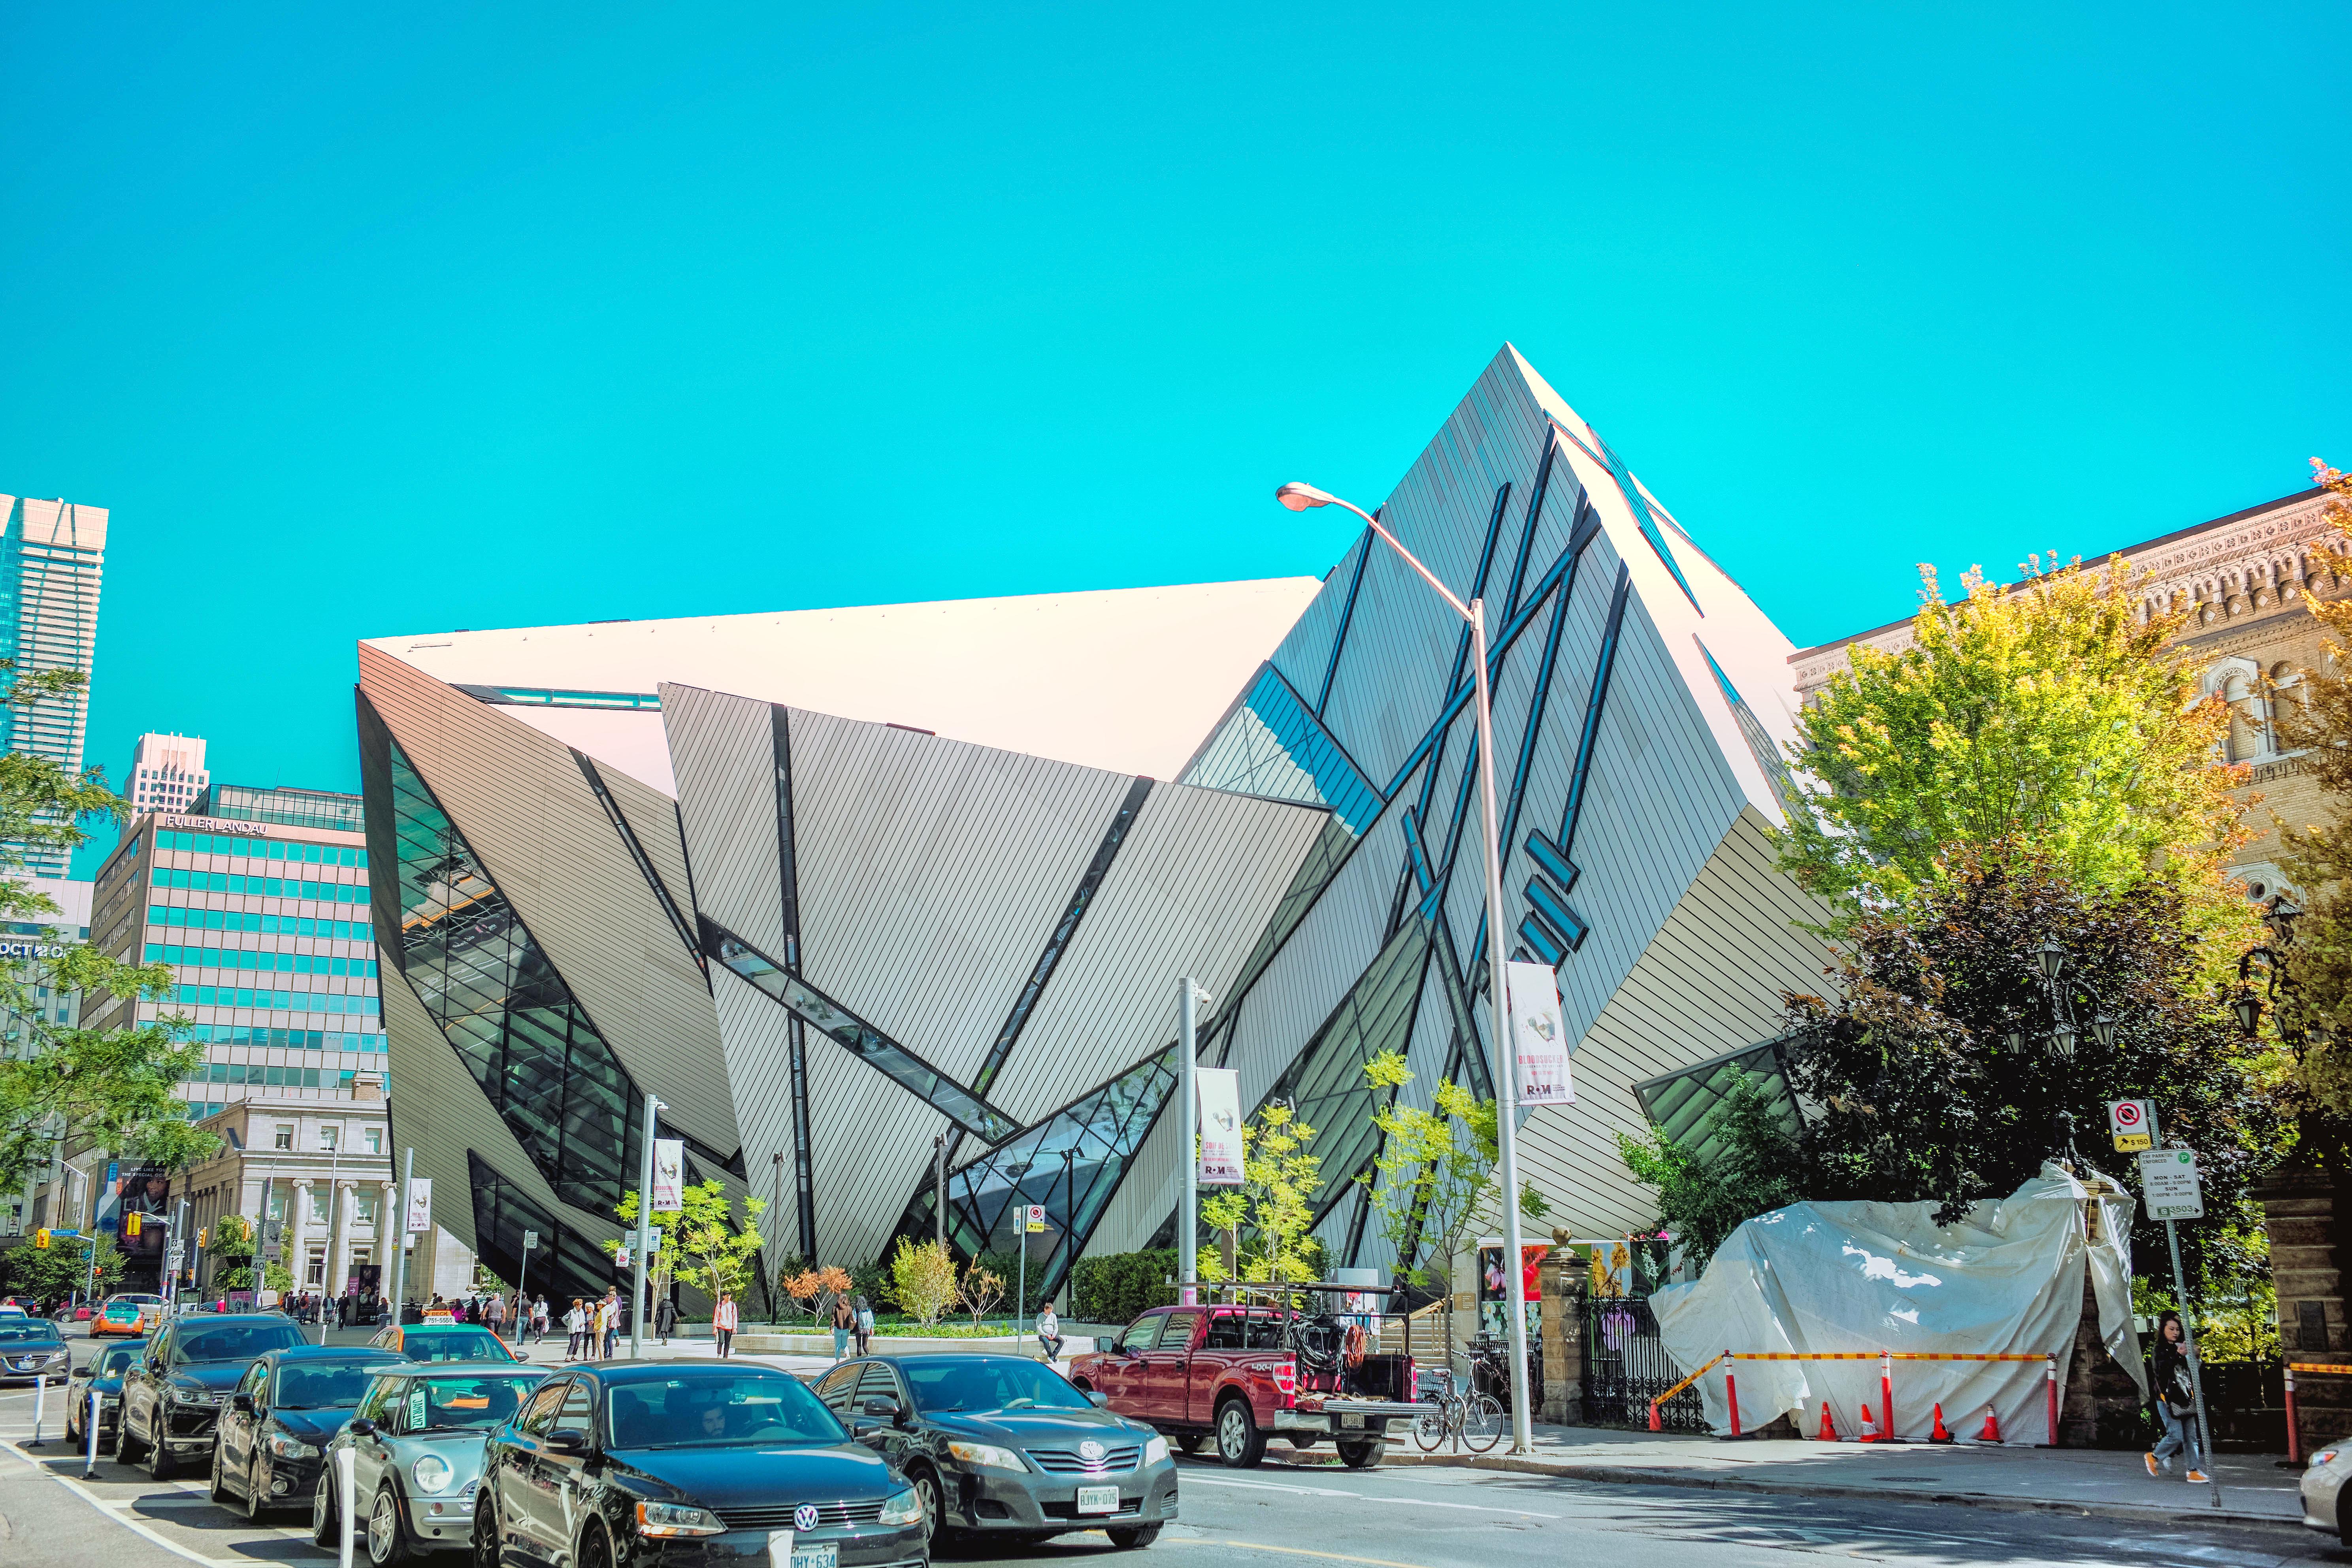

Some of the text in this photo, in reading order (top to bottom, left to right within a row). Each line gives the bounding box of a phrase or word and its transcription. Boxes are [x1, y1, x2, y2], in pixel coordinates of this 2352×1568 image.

[167, 815, 268, 834] FULLER LANDAU
[1519, 1055, 1568, 1064] BLOODSUCKER
[1080, 1494, 1098, 1506] BJYK
[790, 1554, 835, 1568] DHY 634
